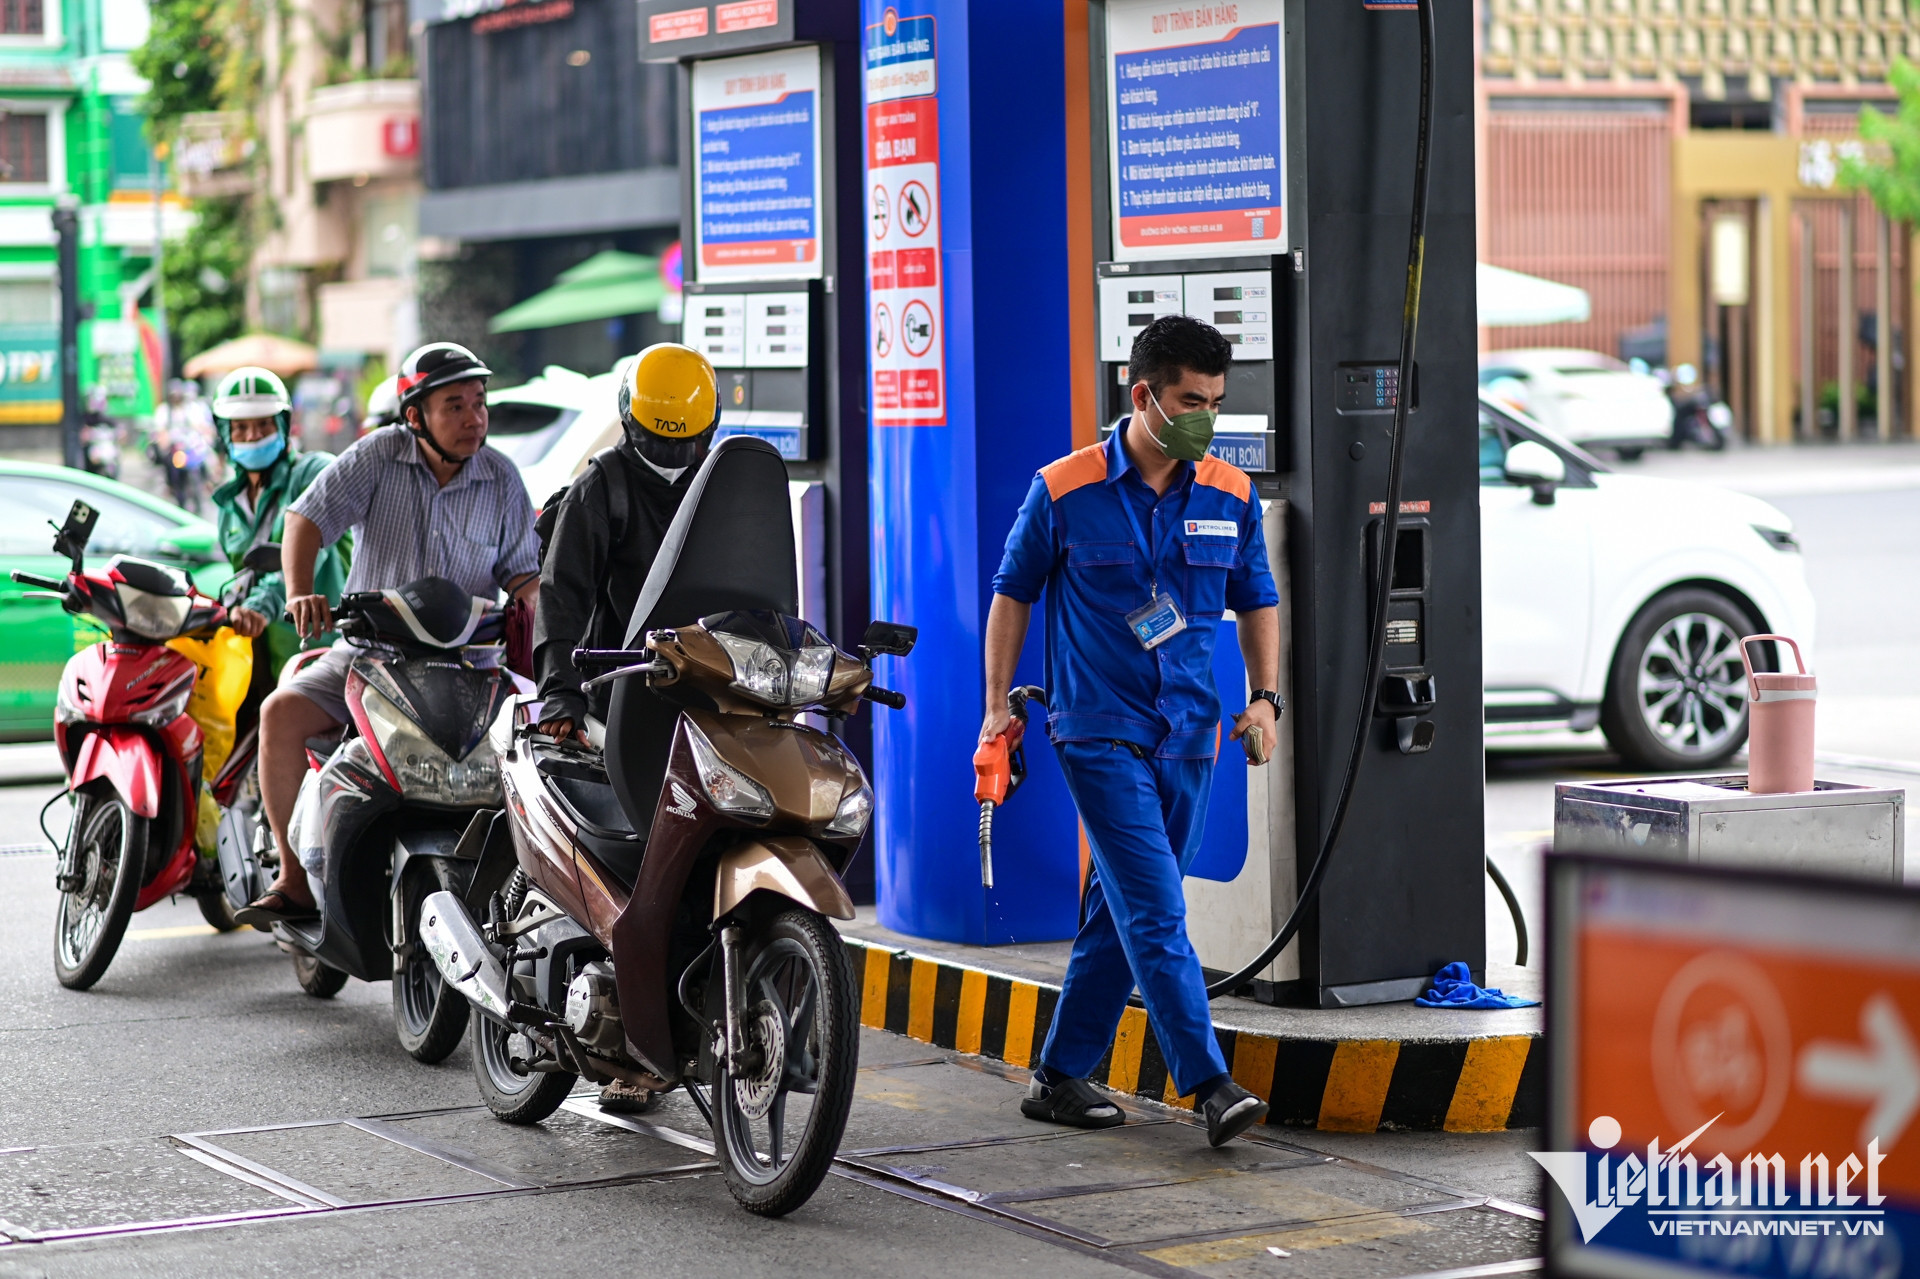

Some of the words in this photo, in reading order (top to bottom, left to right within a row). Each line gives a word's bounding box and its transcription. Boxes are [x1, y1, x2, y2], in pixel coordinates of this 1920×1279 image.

[1152, 14, 1168, 34] QUY
[1170, 8, 1194, 32] TRÌNH
[1196, 4, 1213, 28] BÁN
[1215, 1, 1238, 26] HÀNG
[893, 138, 917, 162] BẠN
[654, 417, 687, 433] TADA
[1219, 446, 1236, 465] KHI
[1238, 445, 1262, 466] BƠM
[427, 661, 462, 669] HONDA
[666, 805, 697, 820] HONDA
